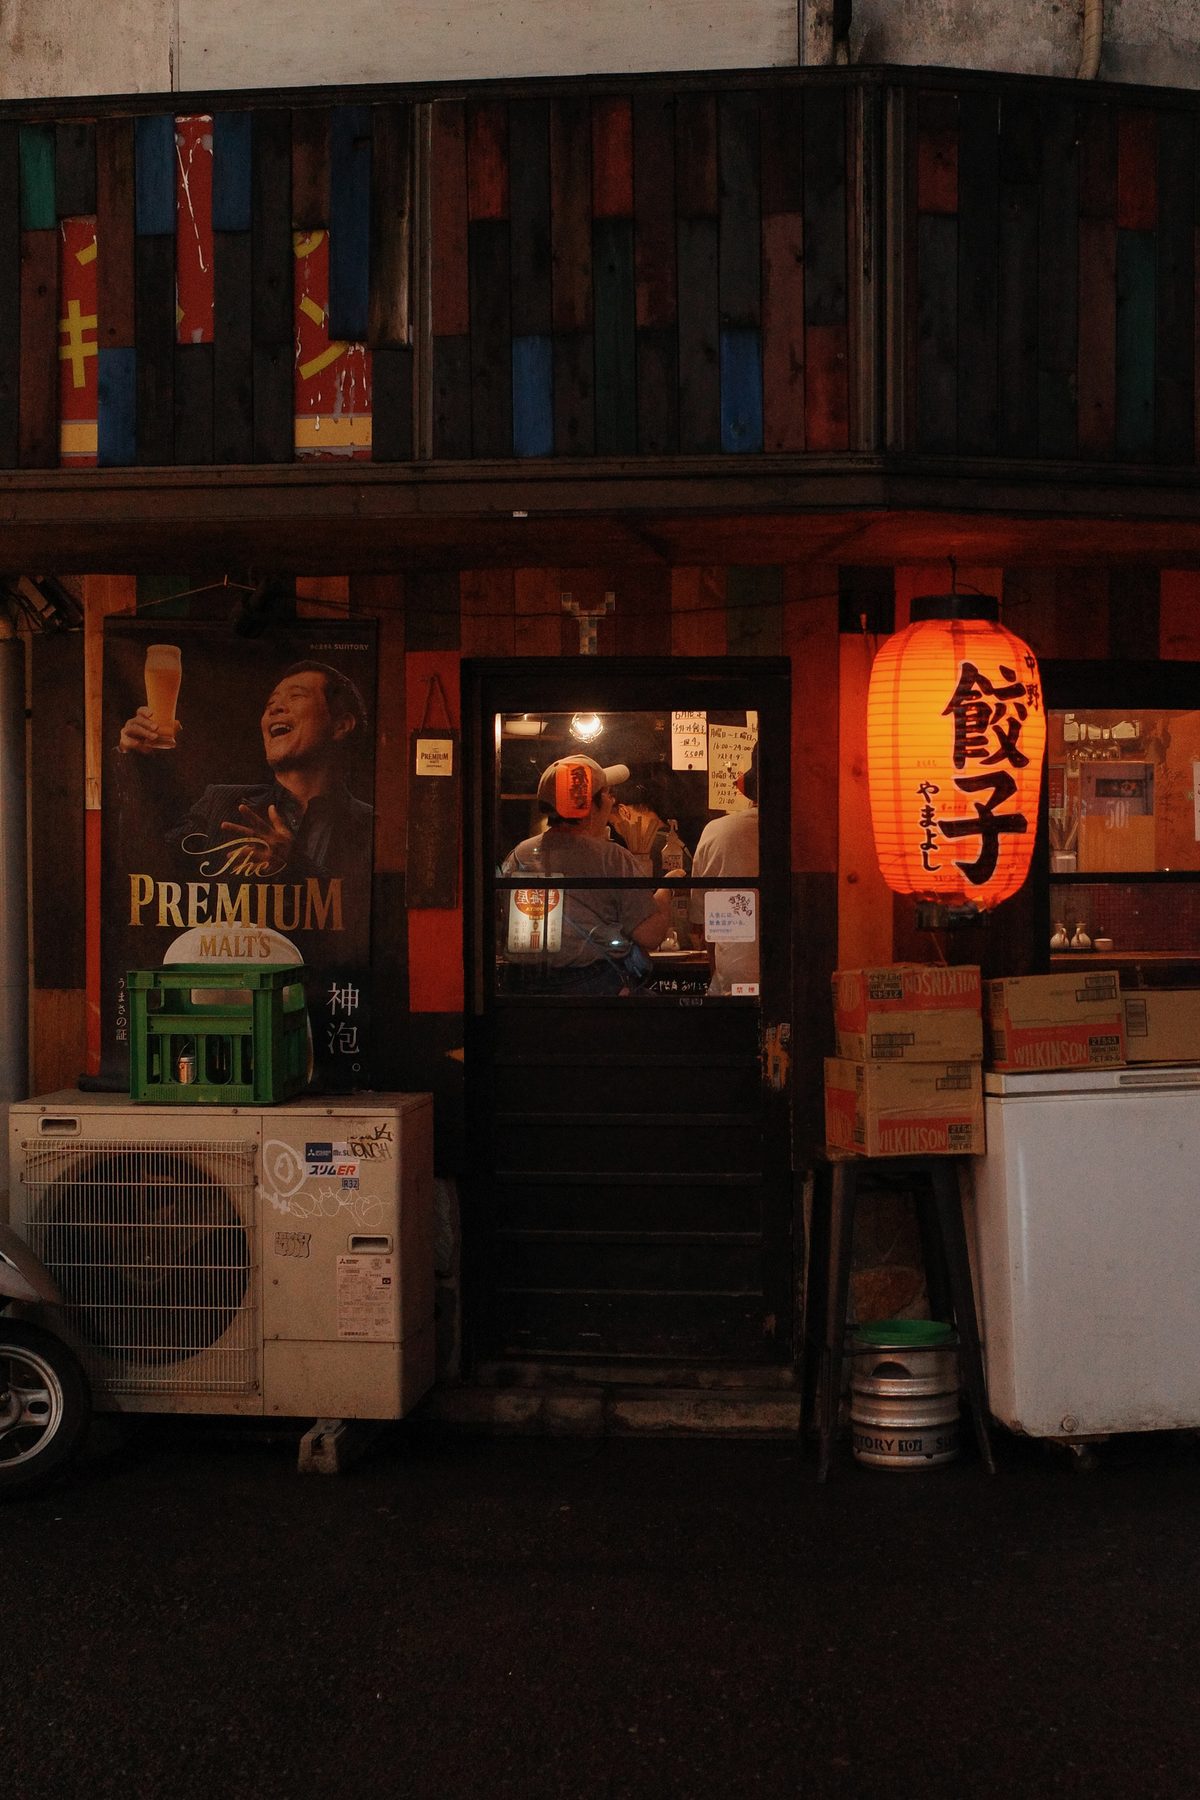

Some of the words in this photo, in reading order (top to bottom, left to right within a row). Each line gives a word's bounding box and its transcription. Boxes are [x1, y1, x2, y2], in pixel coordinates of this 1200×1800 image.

[1024, 650, 1042, 711] 中野
[421, 752, 449, 761] PREMIUM
[937, 662, 1030, 886] 餃子
[916, 781, 942, 872] やまよし
[182, 832, 287, 878] The
[128, 873, 345, 931] PREMIUM
[200, 933, 271, 959] MALT'S
[903, 969, 978, 997] WILKINSON
[327, 982, 362, 1073] 神泡。
[1013, 1040, 1087, 1067] WILKINSON
[308, 1165, 357, 1176] スリムER
[343, 1179, 359, 1189] R32
